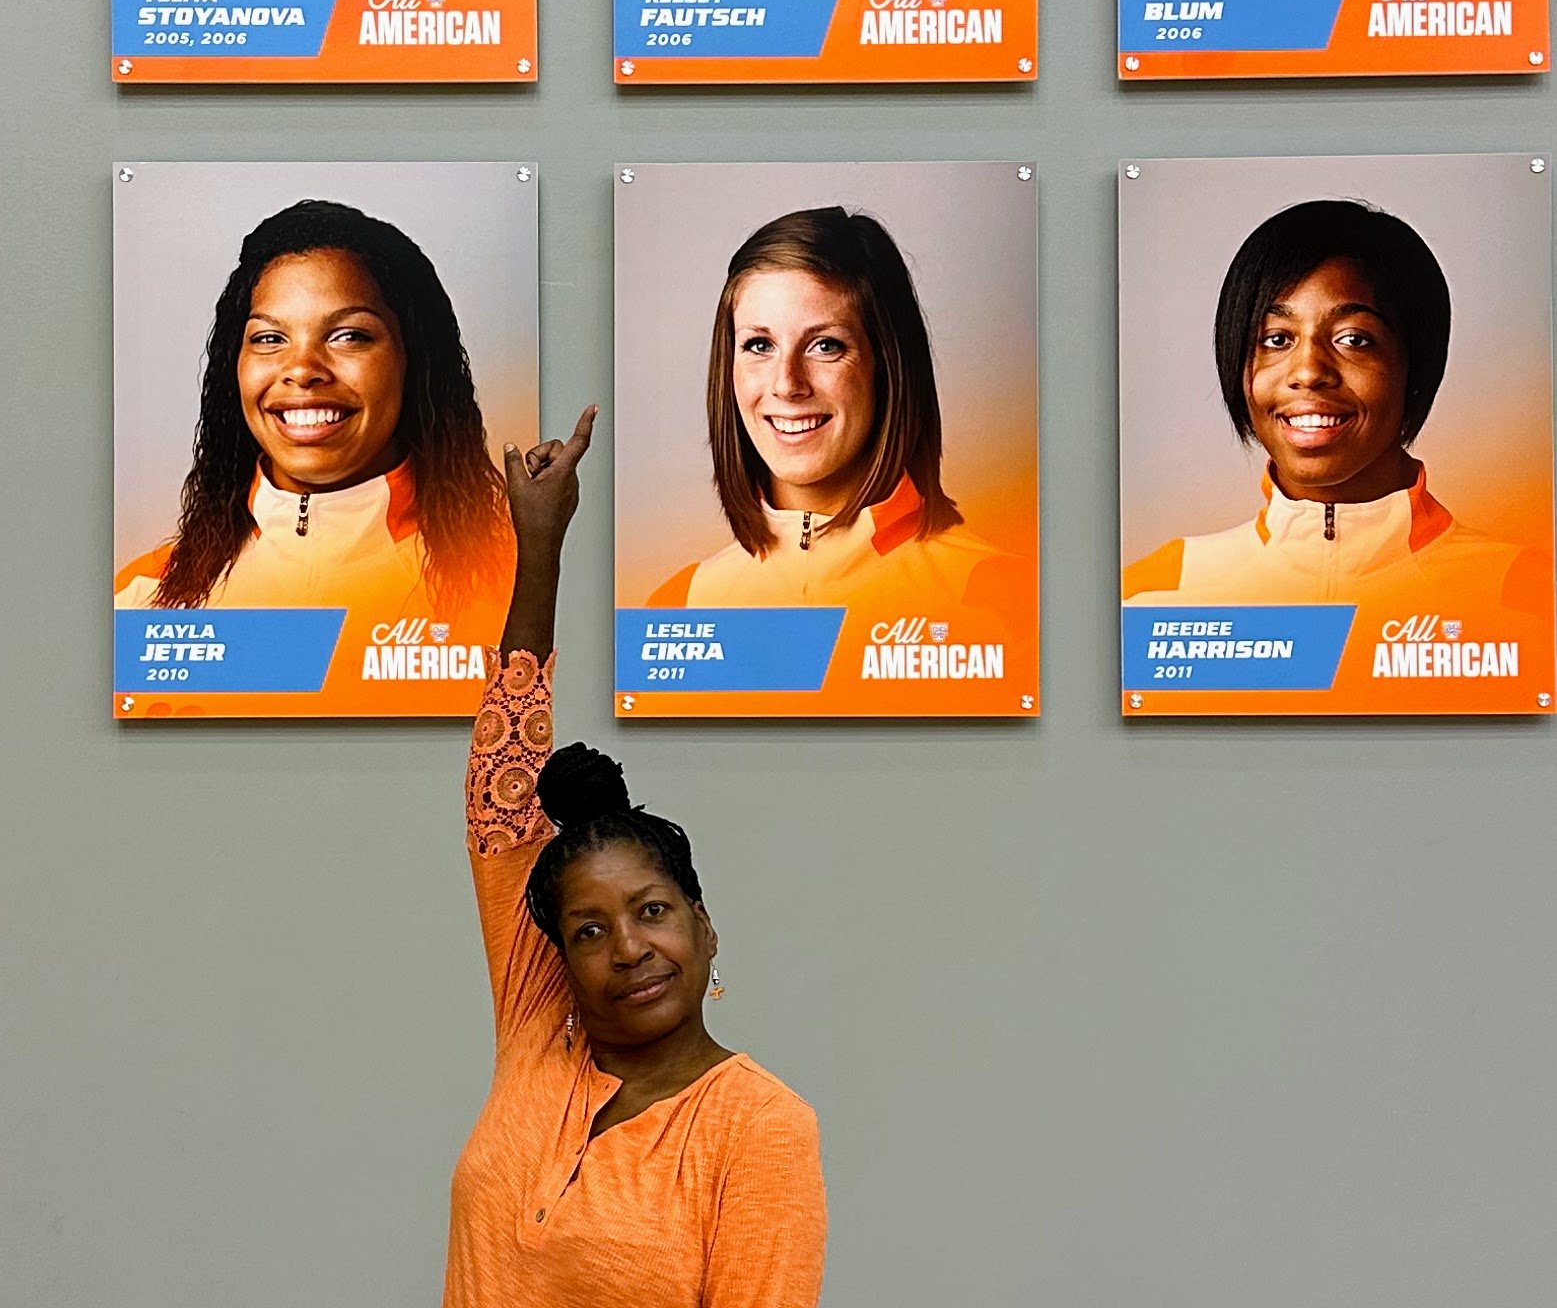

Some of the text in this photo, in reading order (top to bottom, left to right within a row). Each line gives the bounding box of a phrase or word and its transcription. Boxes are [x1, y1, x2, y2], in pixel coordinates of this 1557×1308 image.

[137, 7, 305, 26] STOYANOVA
[639, 8, 766, 27] FAUTSCH
[1143, 1, 1224, 21] BLUM
[1367, 1, 1512, 37] AMERICAN
[359, 11, 500, 45] AMERICAN
[860, 10, 1002, 45] AMERICAN
[1155, 27, 1202, 40] 2006
[143, 32, 247, 47] 2005, 2006
[646, 33, 692, 46] 2006
[145, 624, 215, 639] KAYLA
[371, 617, 429, 645] All
[646, 624, 715, 638] LESLIE
[870, 617, 927, 644] All
[1152, 622, 1232, 636] DEEDEE
[1381, 615, 1440, 641] All
[139, 643, 226, 662] JETER
[641, 642, 724, 661] CIKRA
[1147, 640, 1293, 659] HARRISON
[361, 645, 486, 680] AMERICA
[861, 645, 1003, 680] AMERICAN
[1372, 643, 1519, 678] AMERICAN
[146, 668, 189, 681] 2010
[647, 668, 686, 680] 2011
[1153, 665, 1192, 679] 2011
